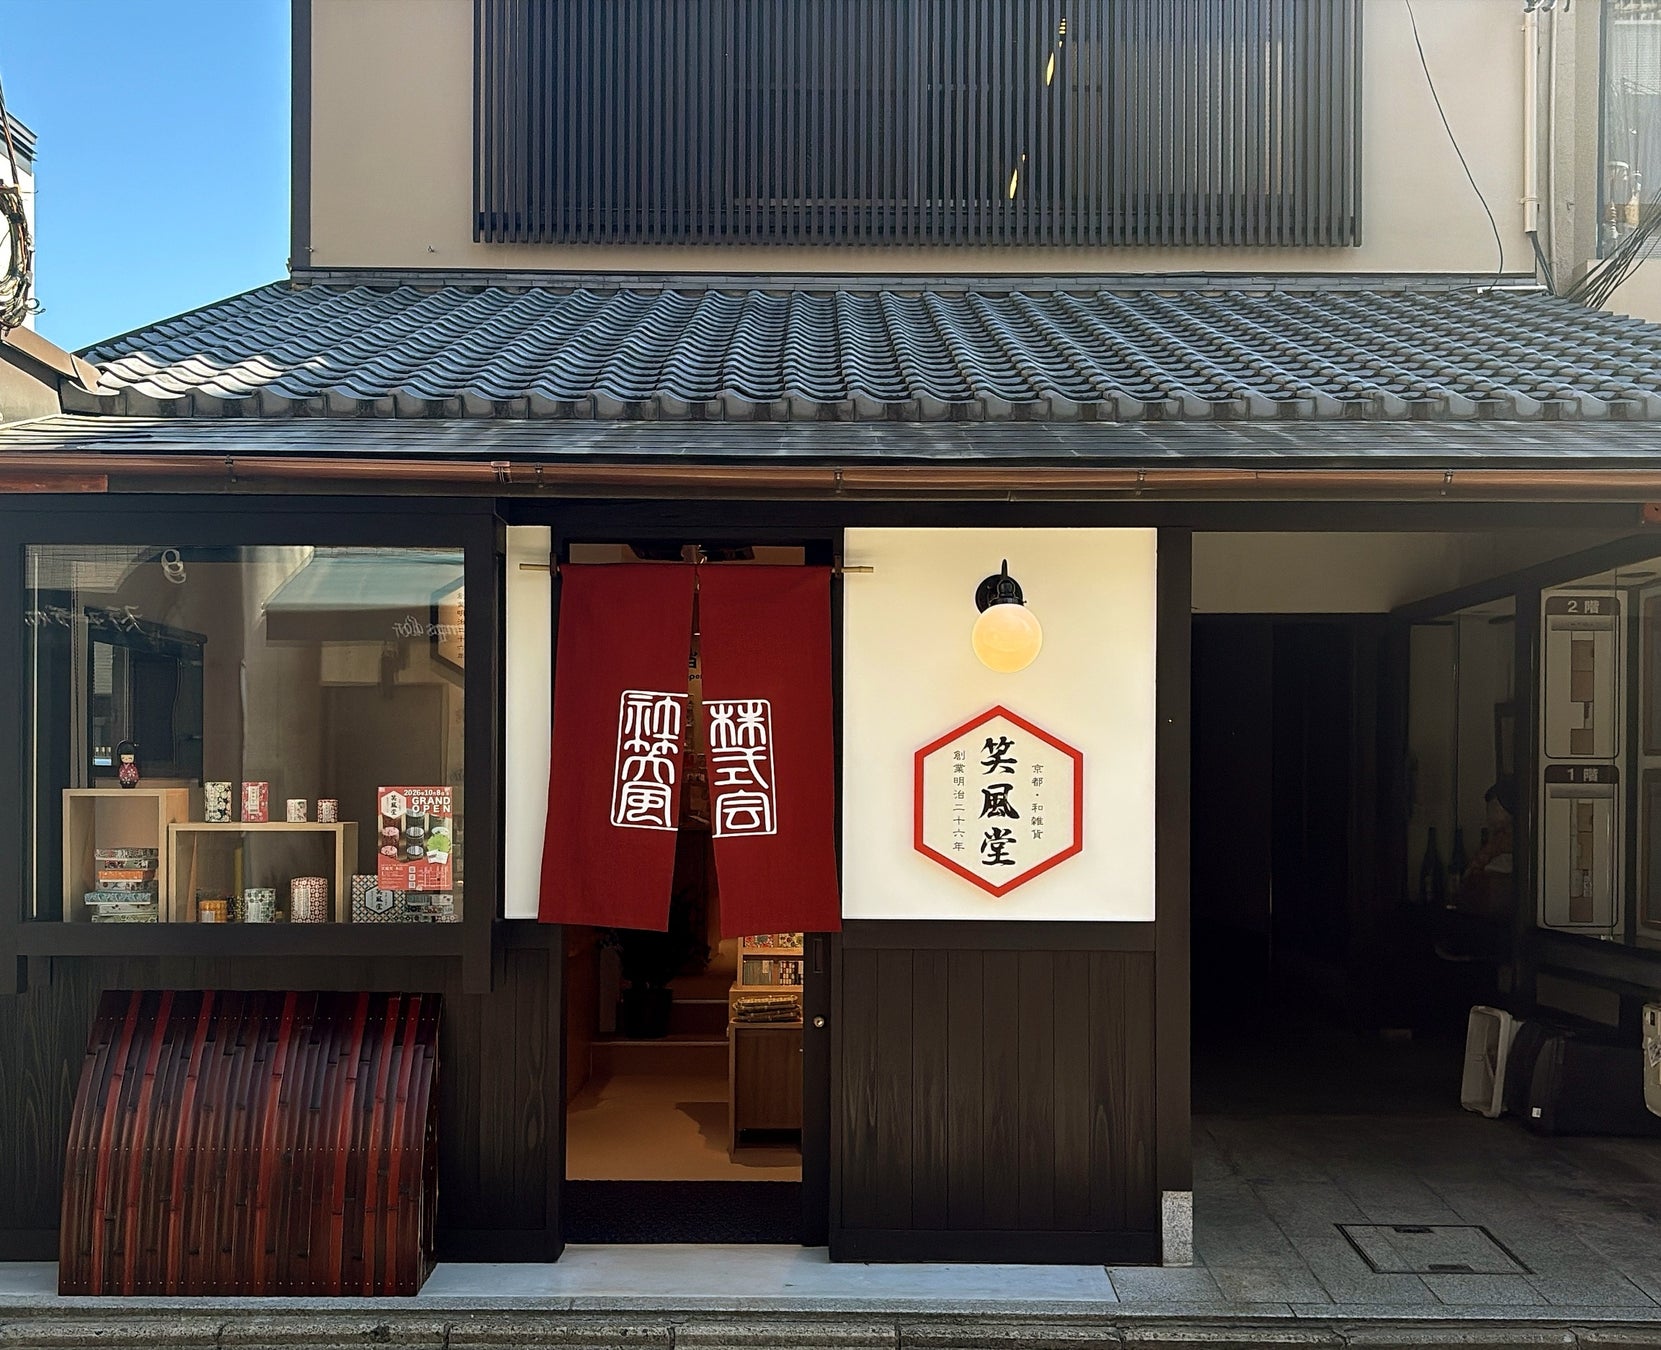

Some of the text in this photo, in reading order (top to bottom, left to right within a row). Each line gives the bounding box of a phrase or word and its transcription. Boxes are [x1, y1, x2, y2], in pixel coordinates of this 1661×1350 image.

[1567, 600, 1600, 614] 2階
[1567, 768, 1599, 782] 1階
[411, 796, 451, 805] GRAND
[952, 750, 966, 851] 創業明治二十六年
[978, 736, 1020, 866] 笑風堂
[1031, 764, 1044, 840] 京都・和雑貨
[412, 804, 451, 813] OPEN
